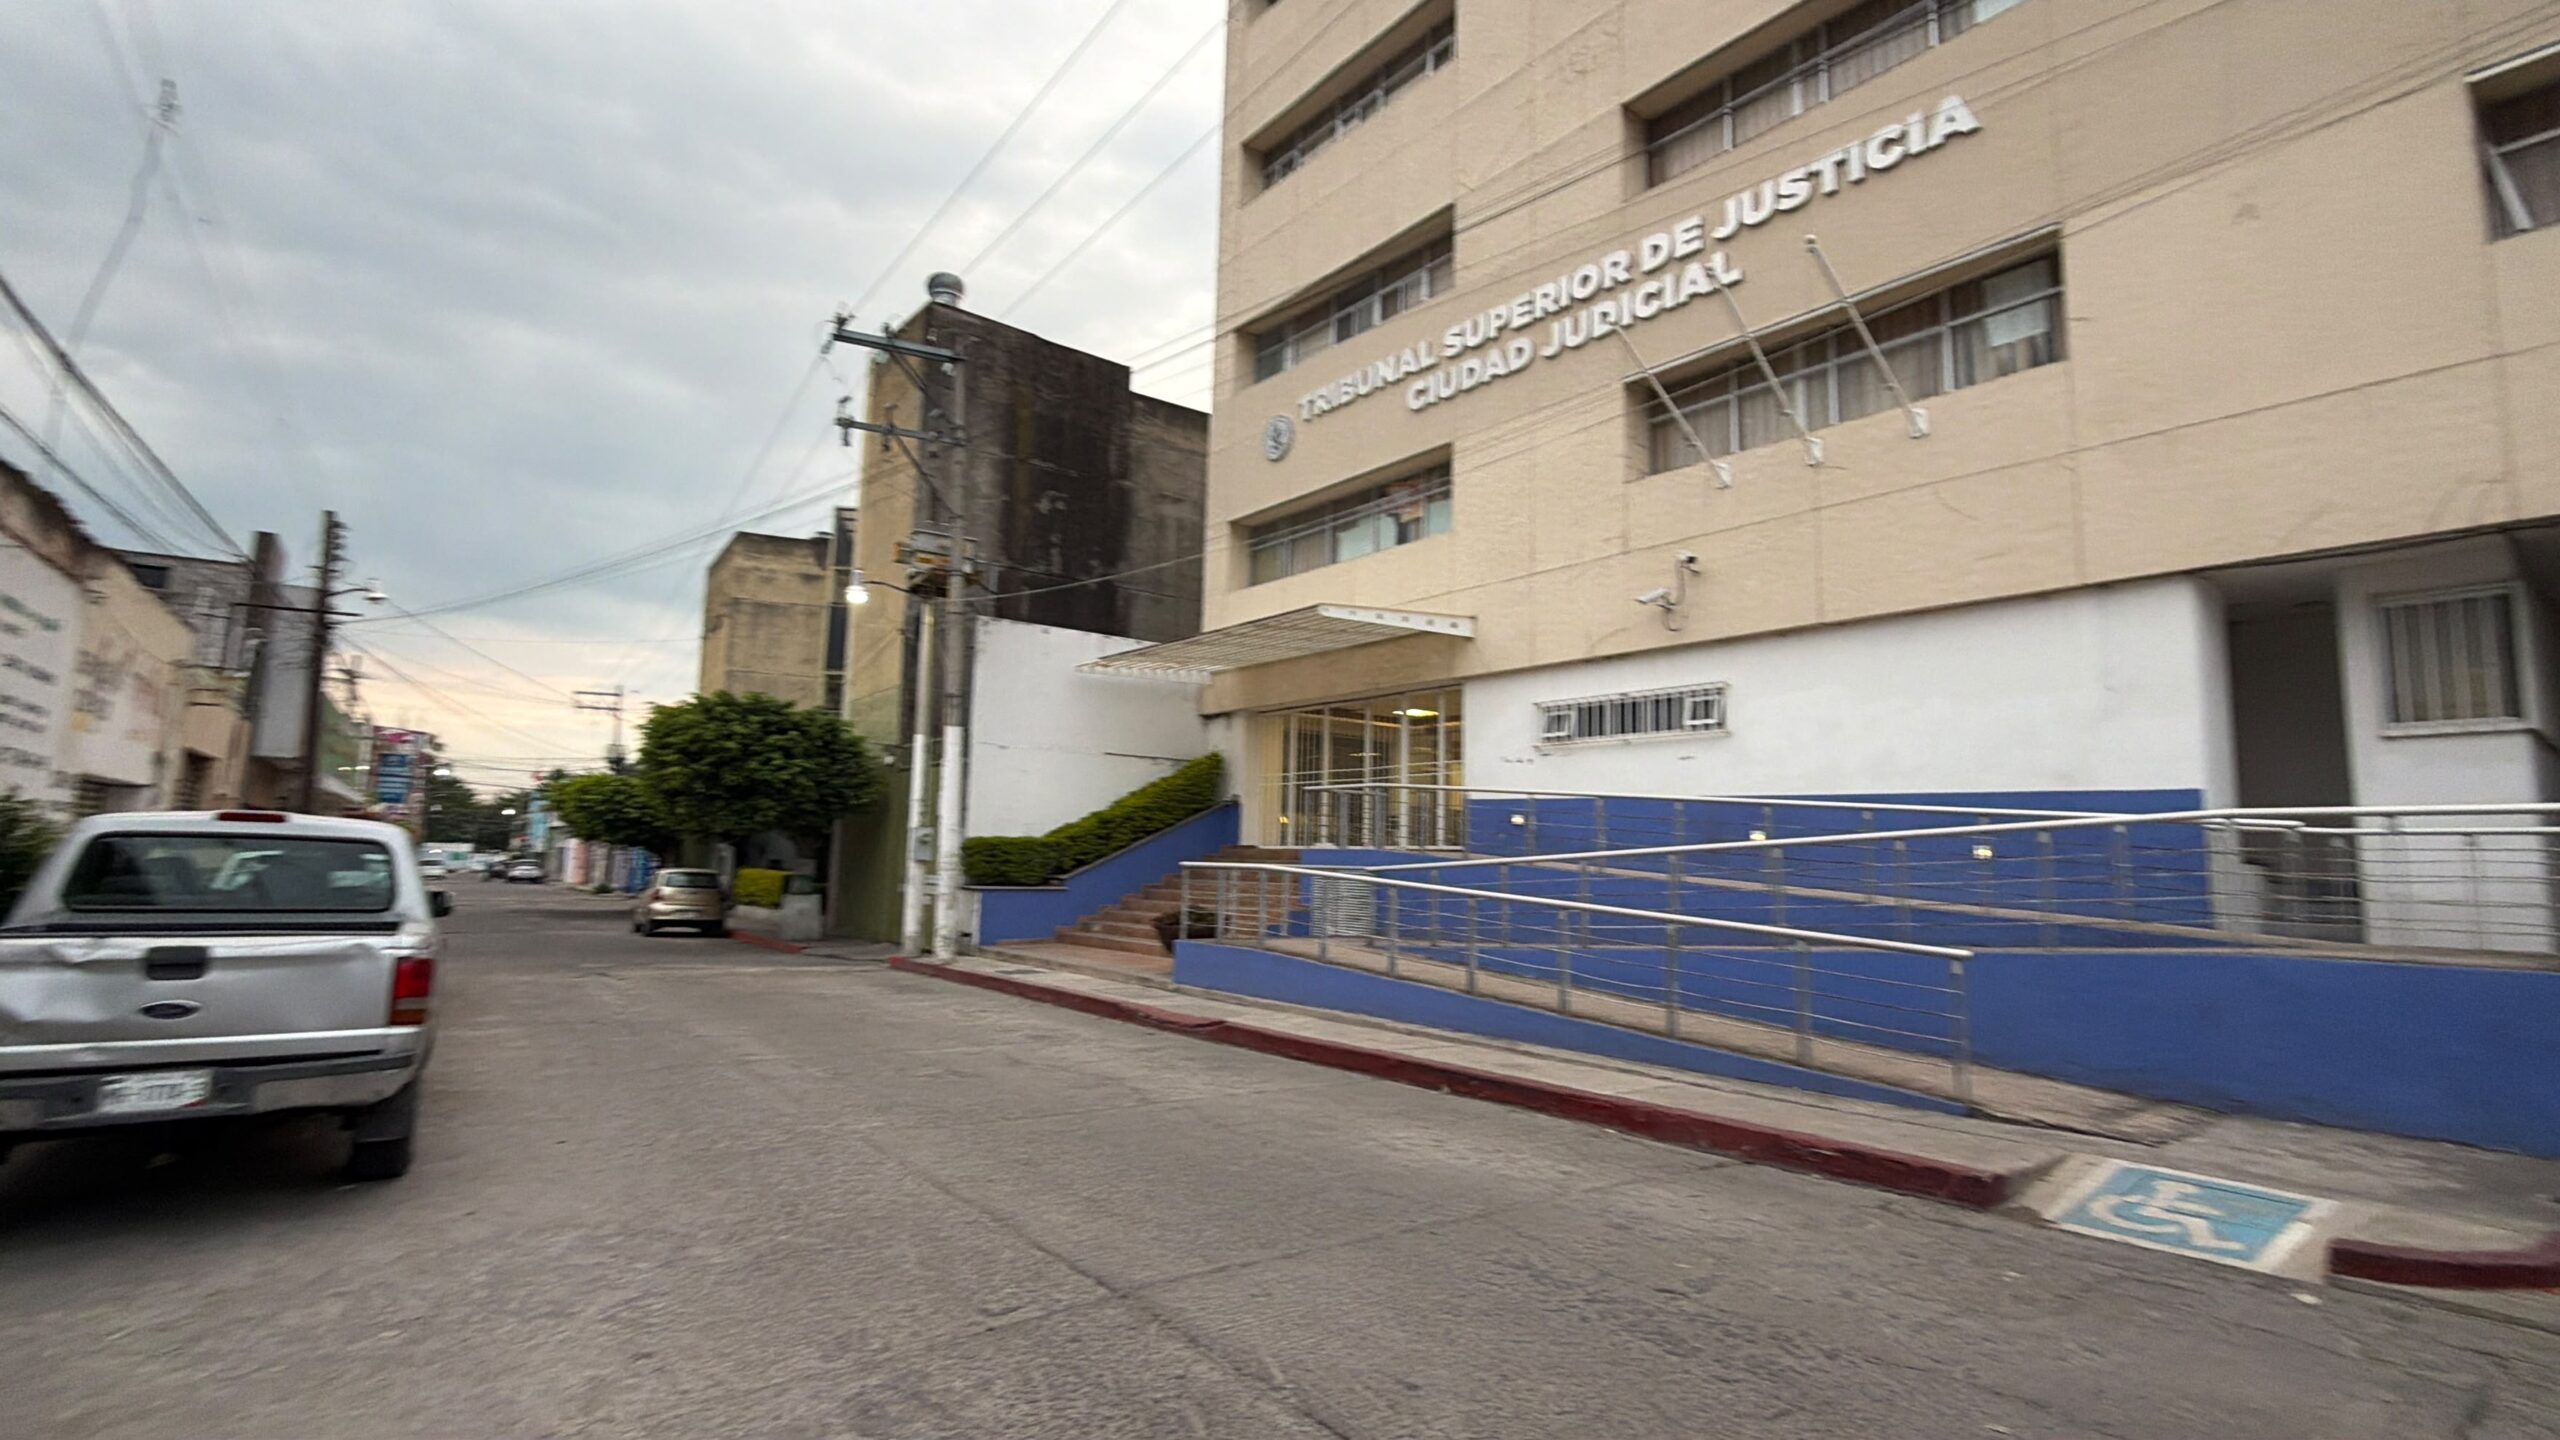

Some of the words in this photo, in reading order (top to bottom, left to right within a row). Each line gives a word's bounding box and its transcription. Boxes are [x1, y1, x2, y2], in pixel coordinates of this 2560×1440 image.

[1299, 340, 1440, 421] TRIBUNAL
[1443, 250, 1633, 357] SUPERIOR
[1640, 214, 1705, 273] DE
[1711, 94, 1983, 240] JUSTICIA
[1407, 336, 1536, 411] CIUDAD
[1540, 251, 1744, 358] JUDICIAL
